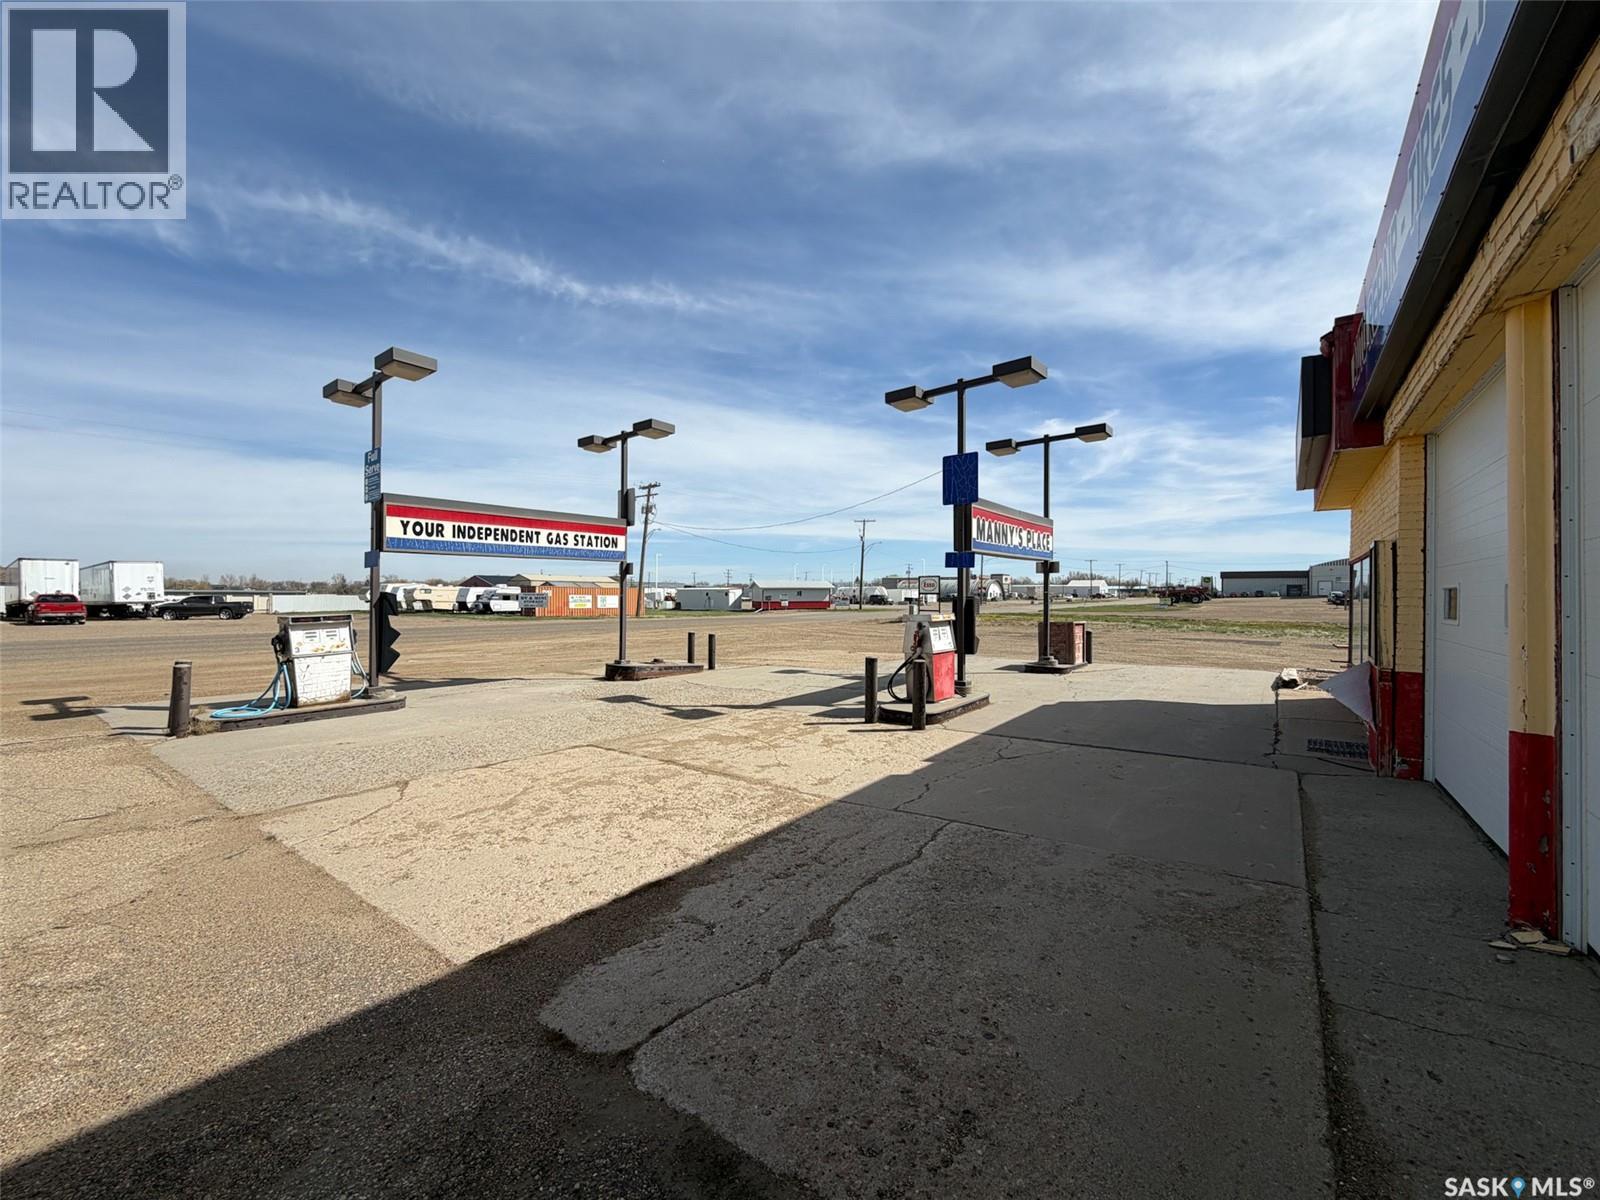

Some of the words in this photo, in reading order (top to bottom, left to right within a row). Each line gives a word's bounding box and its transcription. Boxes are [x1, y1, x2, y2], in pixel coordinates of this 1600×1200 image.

[1407, 24, 1454, 231] TIRES
[400, 519, 445, 538] YOUR
[452, 524, 541, 544] INDEPENDENT
[546, 531, 569, 546] GAS
[573, 533, 618, 549] STATION
[976, 517, 1023, 549] MANNY'S
[1026, 530, 1050, 551] PLACE
